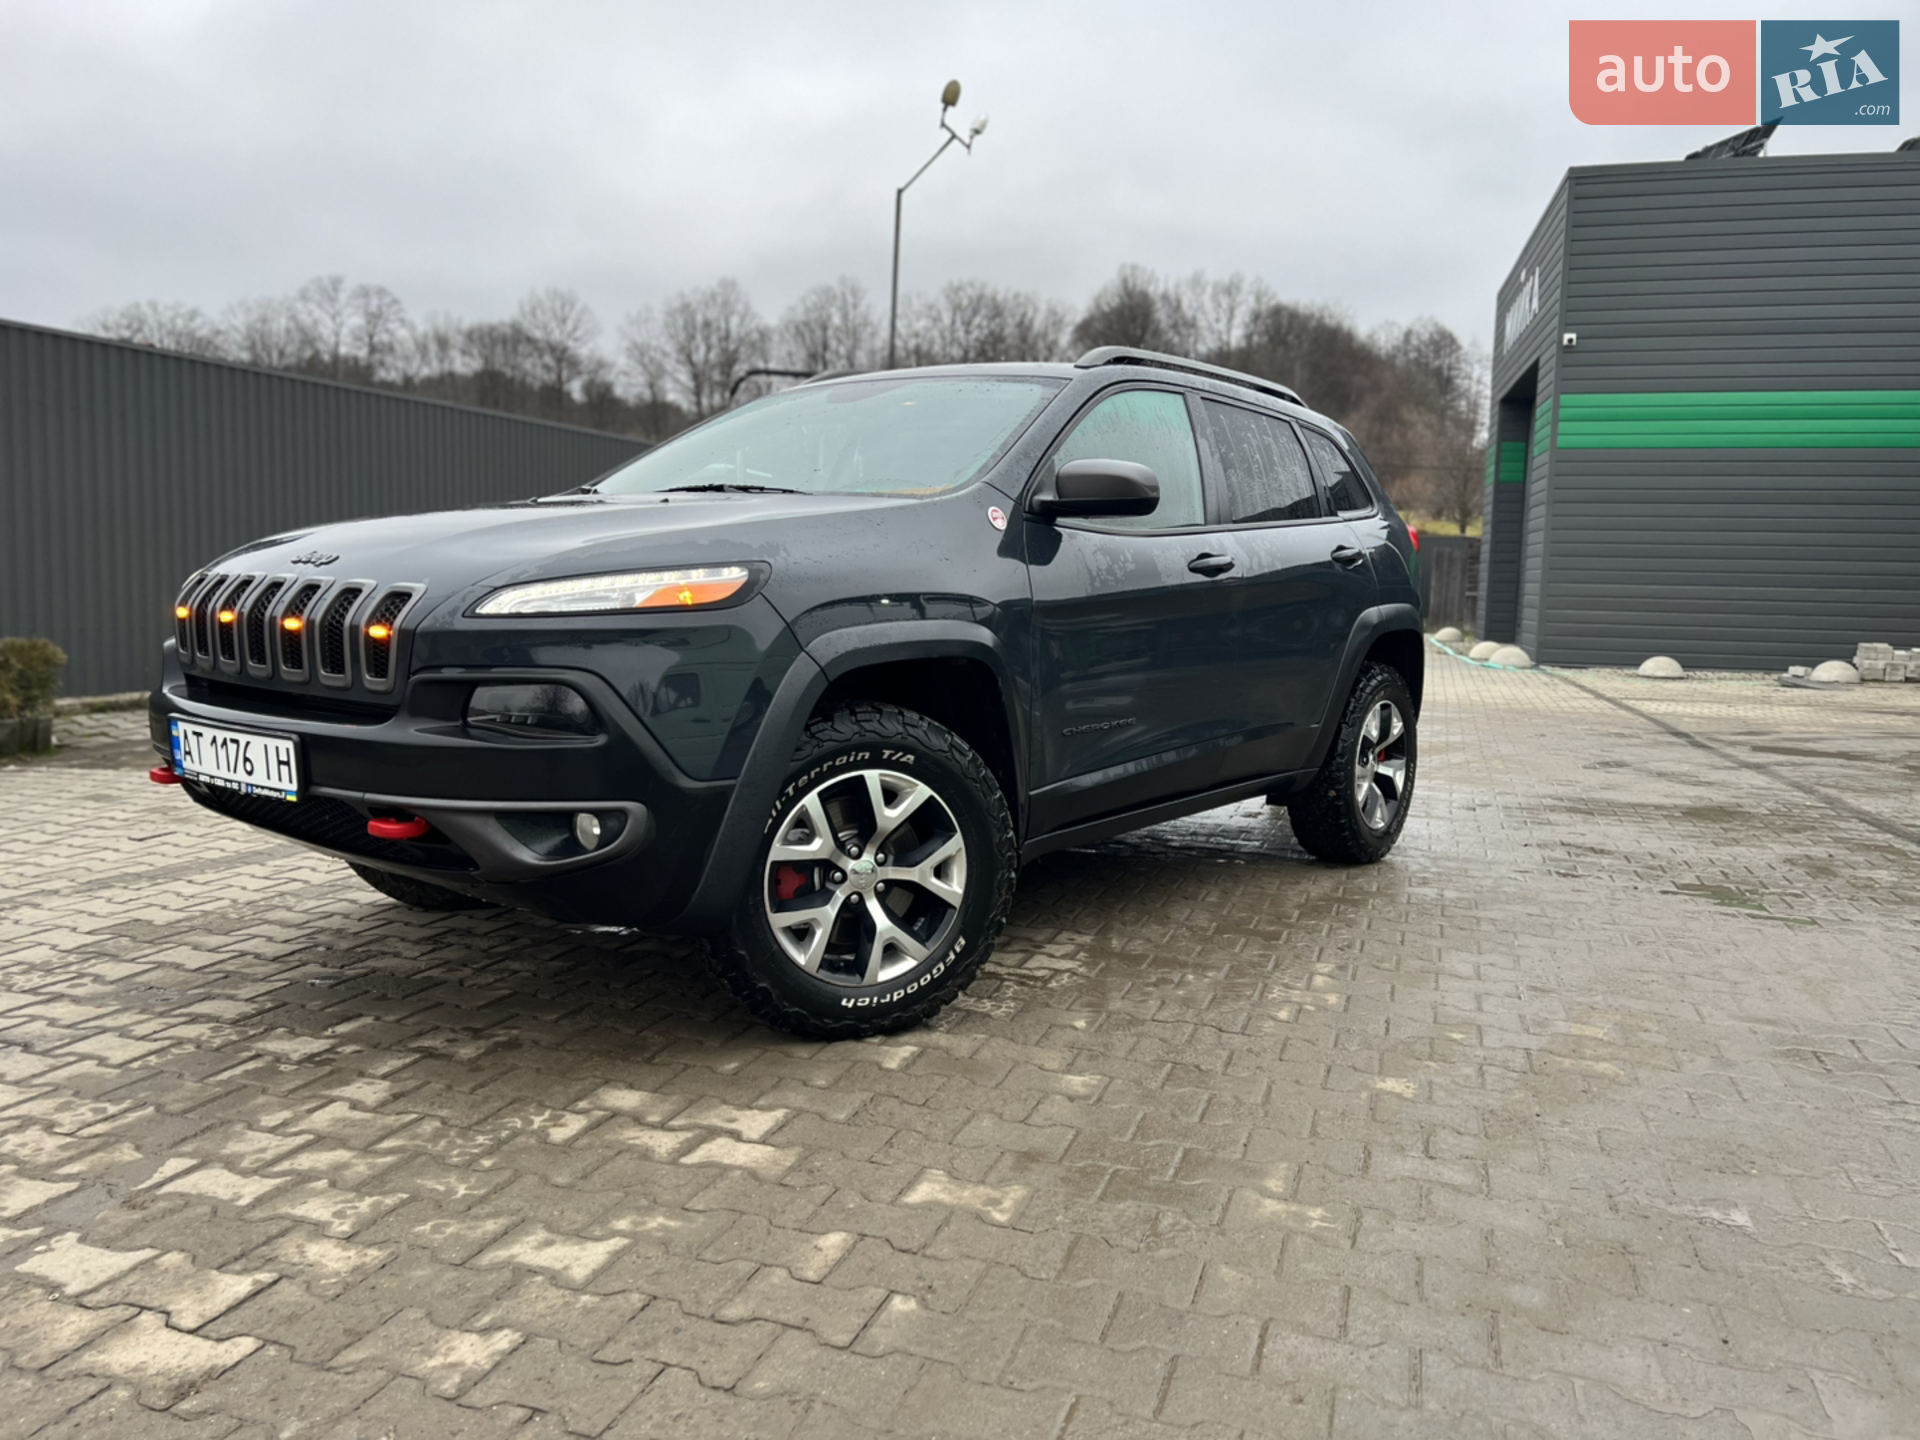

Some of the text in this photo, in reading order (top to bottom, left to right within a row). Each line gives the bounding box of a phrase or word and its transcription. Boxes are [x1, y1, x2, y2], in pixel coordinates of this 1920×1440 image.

[290, 550, 340, 568] Jeep
[1062, 717, 1137, 736] CHEROKEE
[183, 729, 293, 784] AT 1176 IH
[882, 750, 915, 765] T/A
[841, 936, 966, 1008] BFGoodrich
